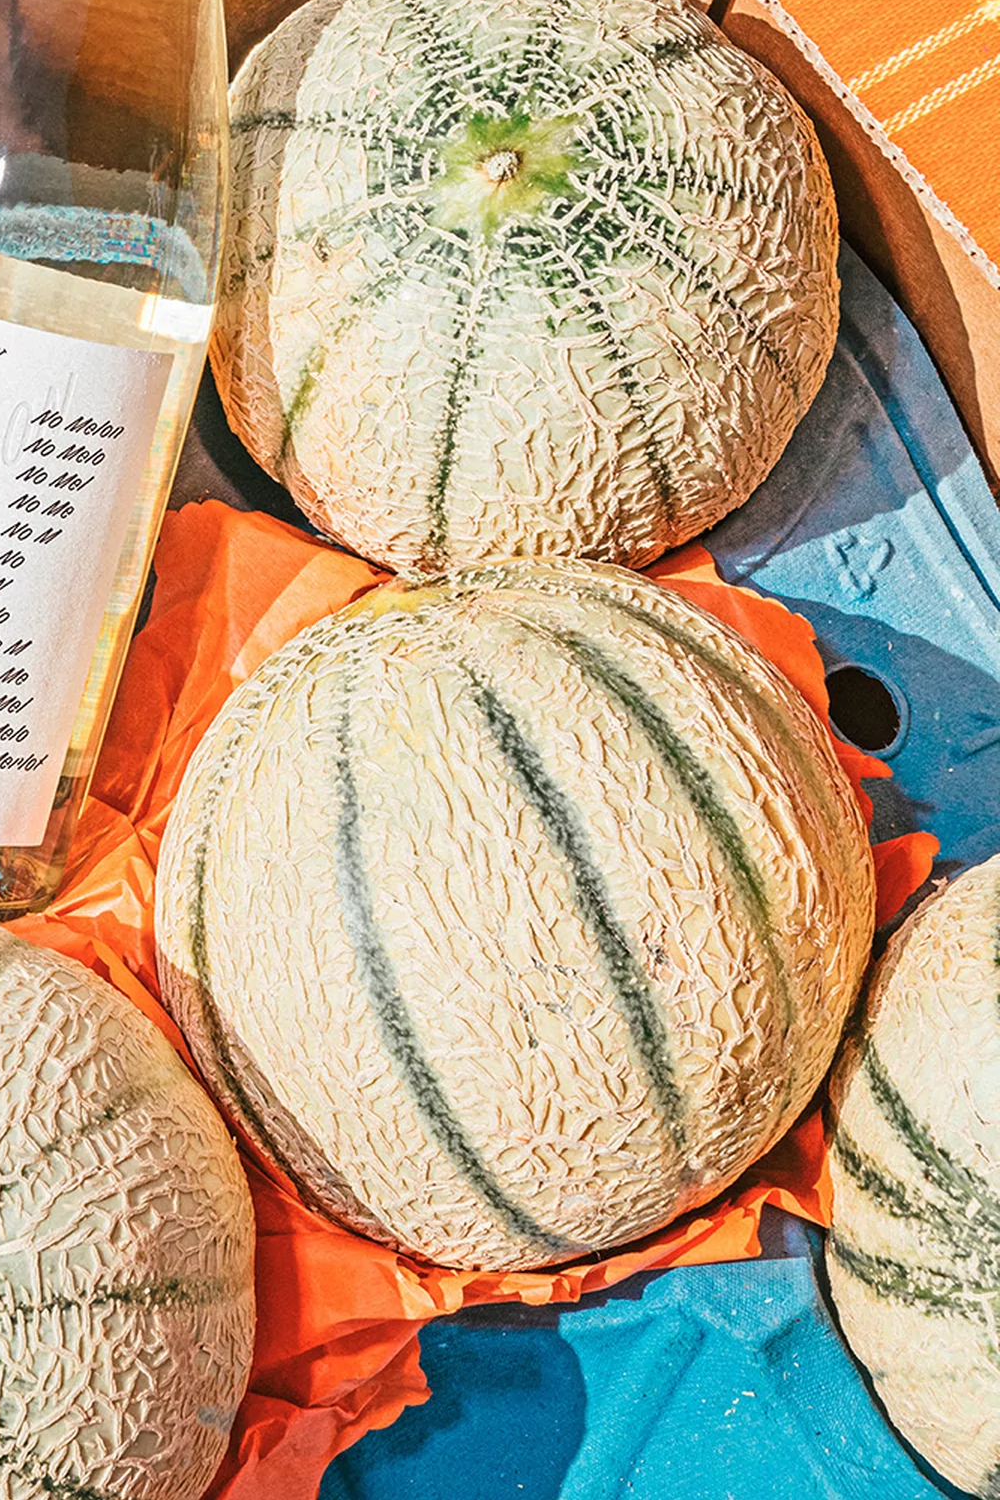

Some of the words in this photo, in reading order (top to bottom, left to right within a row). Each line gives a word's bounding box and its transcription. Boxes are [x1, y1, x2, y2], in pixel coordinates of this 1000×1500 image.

[30, 409, 64, 429] No
[64, 416, 125, 439] Melon
[22, 437, 56, 457] No
[56, 444, 106, 466] Melo
[15, 465, 48, 485] No
[48, 472, 95, 492] Mel
[8, 493, 41, 513] No
[40, 500, 75, 519] Me
[0, 521, 33, 541] No
